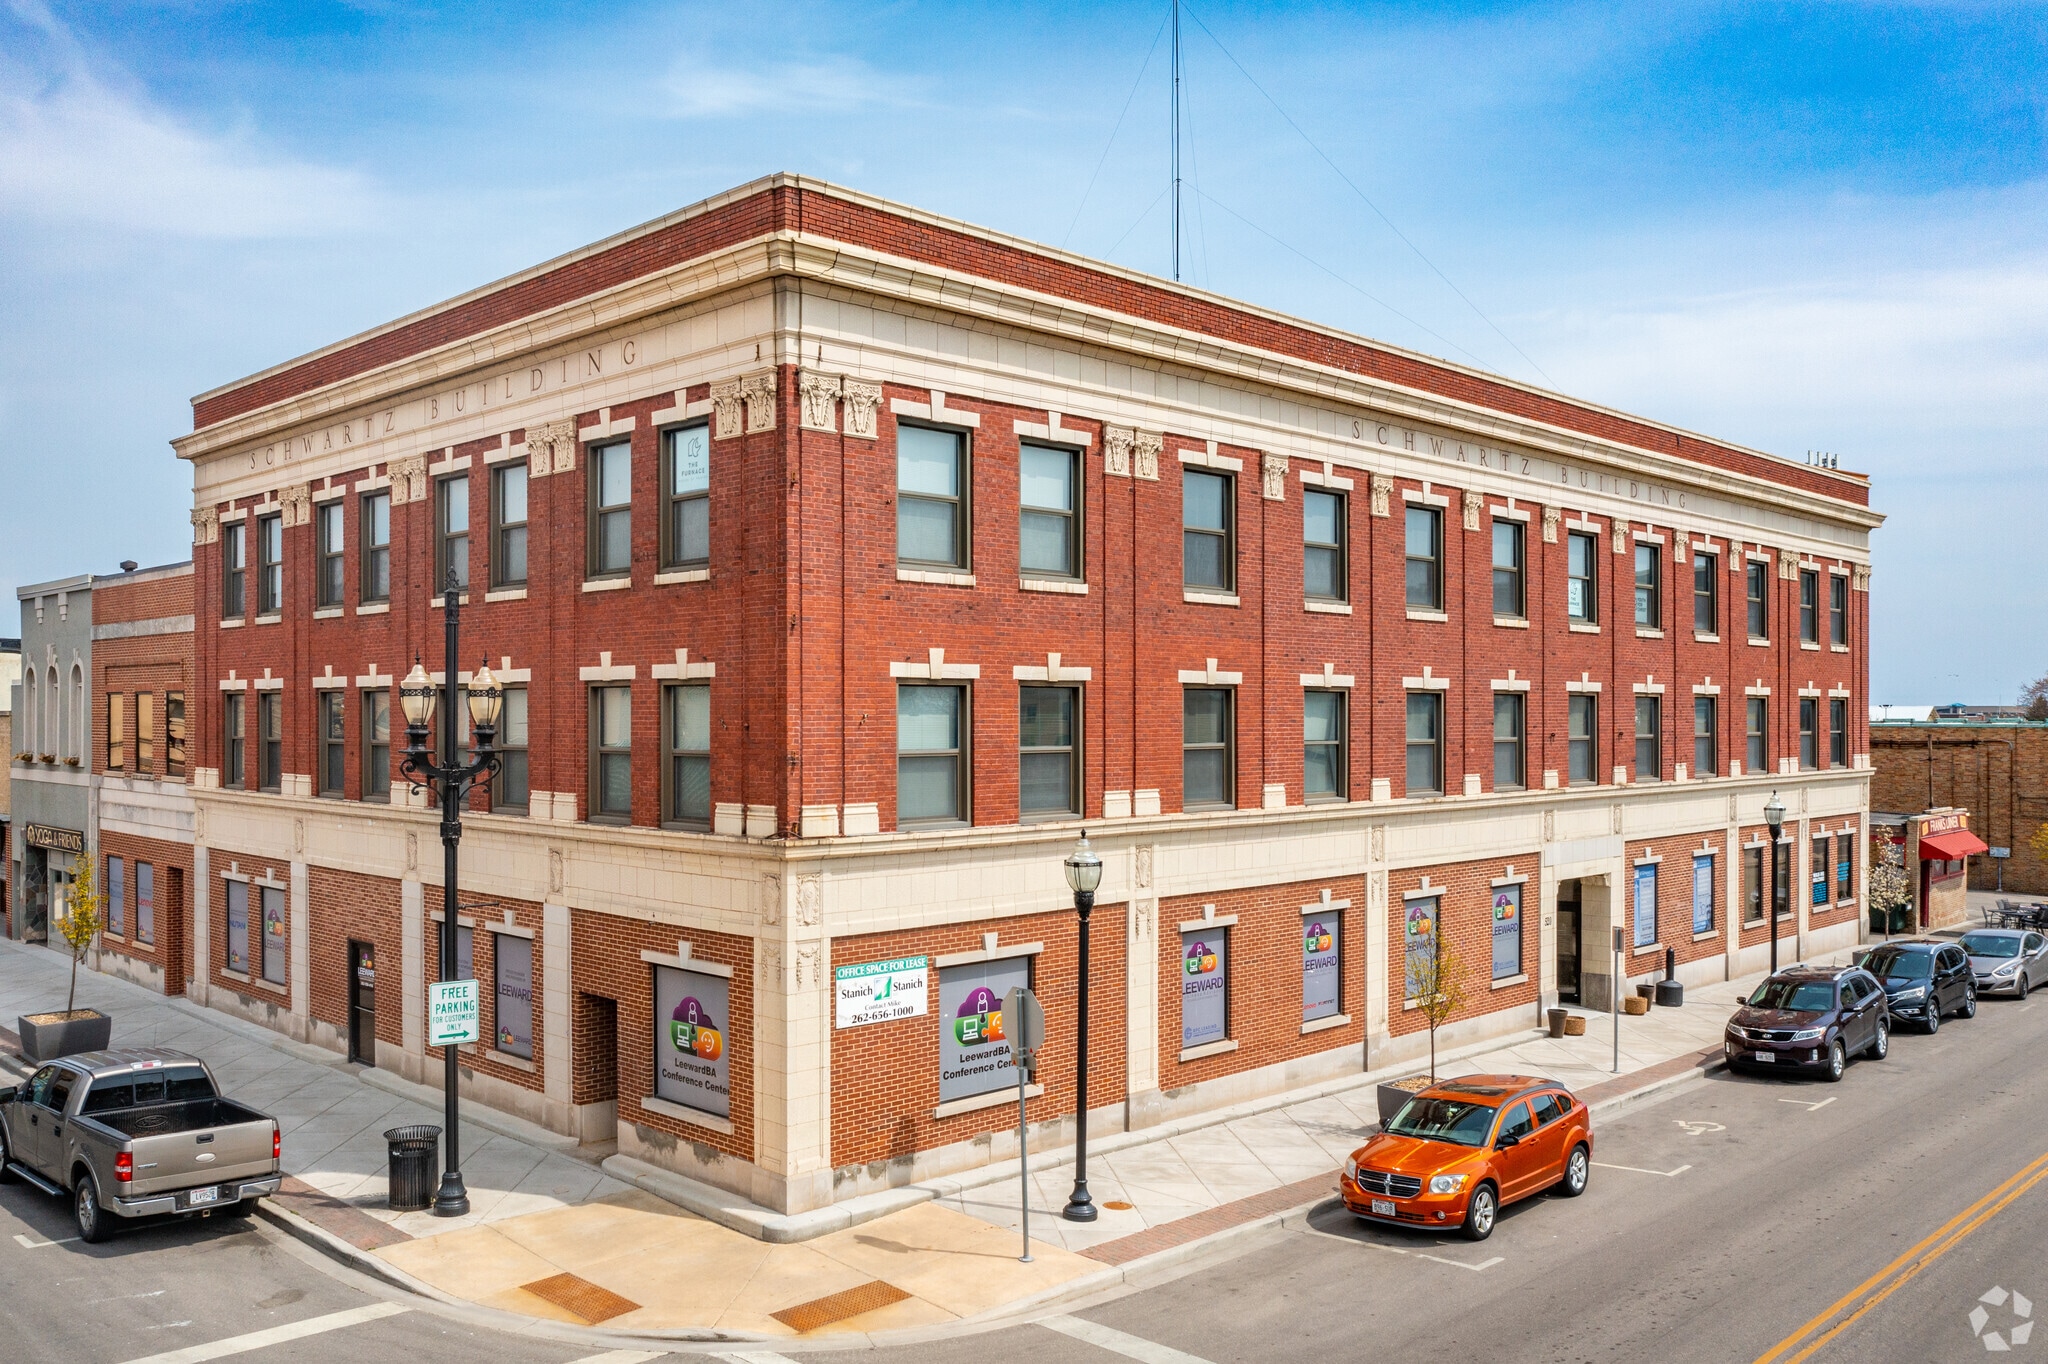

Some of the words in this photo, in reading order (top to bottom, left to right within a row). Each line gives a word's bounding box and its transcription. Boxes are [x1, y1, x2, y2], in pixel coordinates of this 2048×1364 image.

[250, 411, 395, 470] SCHWARTZ
[430, 341, 637, 420] BUILDING
[681, 468, 705, 477] FURNACE
[1353, 420, 1530, 476] SCHWARTZ
[1562, 466, 1686, 508] BUILDING
[35, 828, 52, 845] YOGA
[53, 831, 58, 846] &
[58, 832, 82, 851] FRIENDS
[838, 966, 864, 978] OFFICE
[865, 962, 888, 974] SPACE
[890, 960, 904, 971] FOR
[905, 957, 926, 968] LEASE
[441, 986, 469, 1000] FREE
[498, 983, 532, 1001] LEEWARD
[841, 985, 873, 999] Stanich
[893, 978, 923, 991] Stanich
[435, 1000, 475, 1015] PARKING
[851, 1005, 914, 1024] 262-656-1000
[865, 1001, 886, 1011] Contact
[433, 1016, 443, 1024] FOR
[445, 1012, 476, 1023] CUSTOMERS
[446, 1023, 461, 1031] ONLY
[959, 1045, 1010, 1063] LeewardBA
[674, 1057, 717, 1078] LeewardBA
[943, 1064, 995, 1080] Conference
[661, 1068, 703, 1088] Conference
